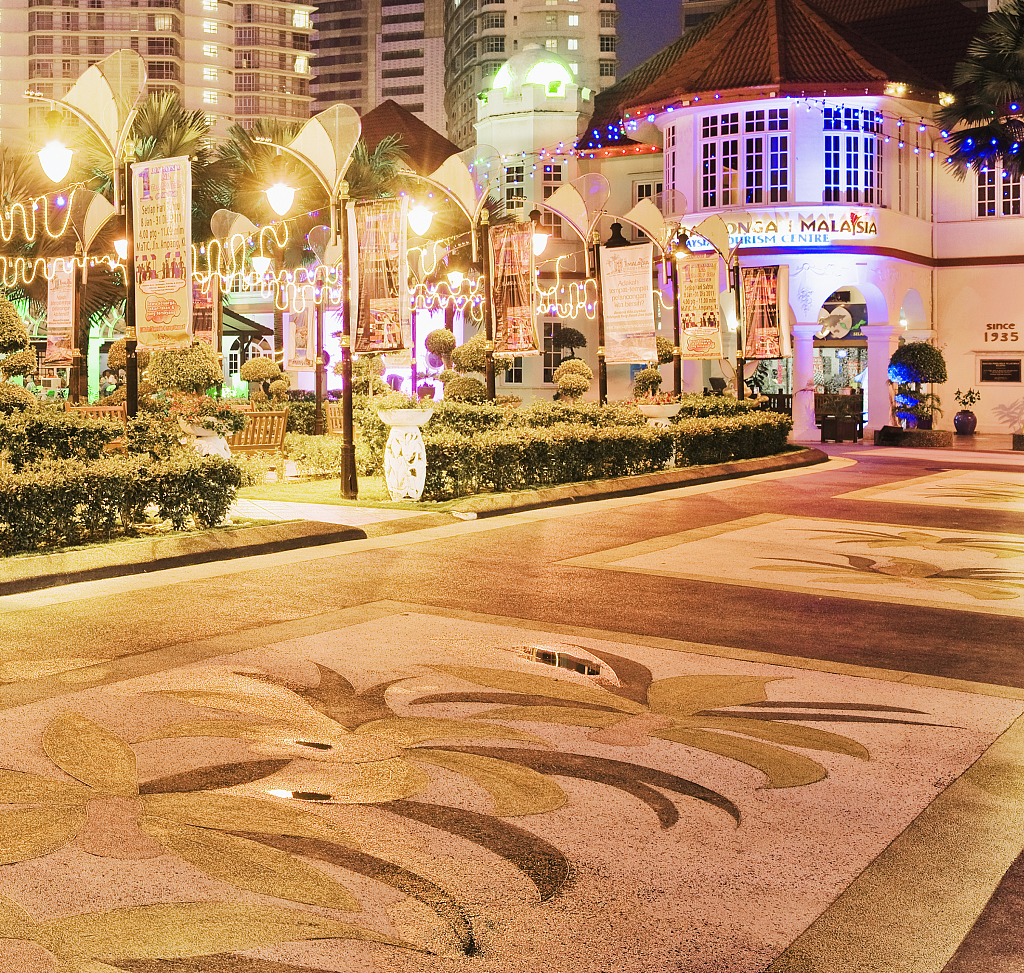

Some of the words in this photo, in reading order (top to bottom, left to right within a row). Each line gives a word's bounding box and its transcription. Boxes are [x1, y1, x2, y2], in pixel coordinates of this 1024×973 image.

[800, 213, 878, 236] MALAYSIA
[728, 234, 776, 245] OURISM
[780, 233, 830, 244] CENTRE
[986, 322, 1016, 331] since
[984, 331, 1019, 343] 1935
